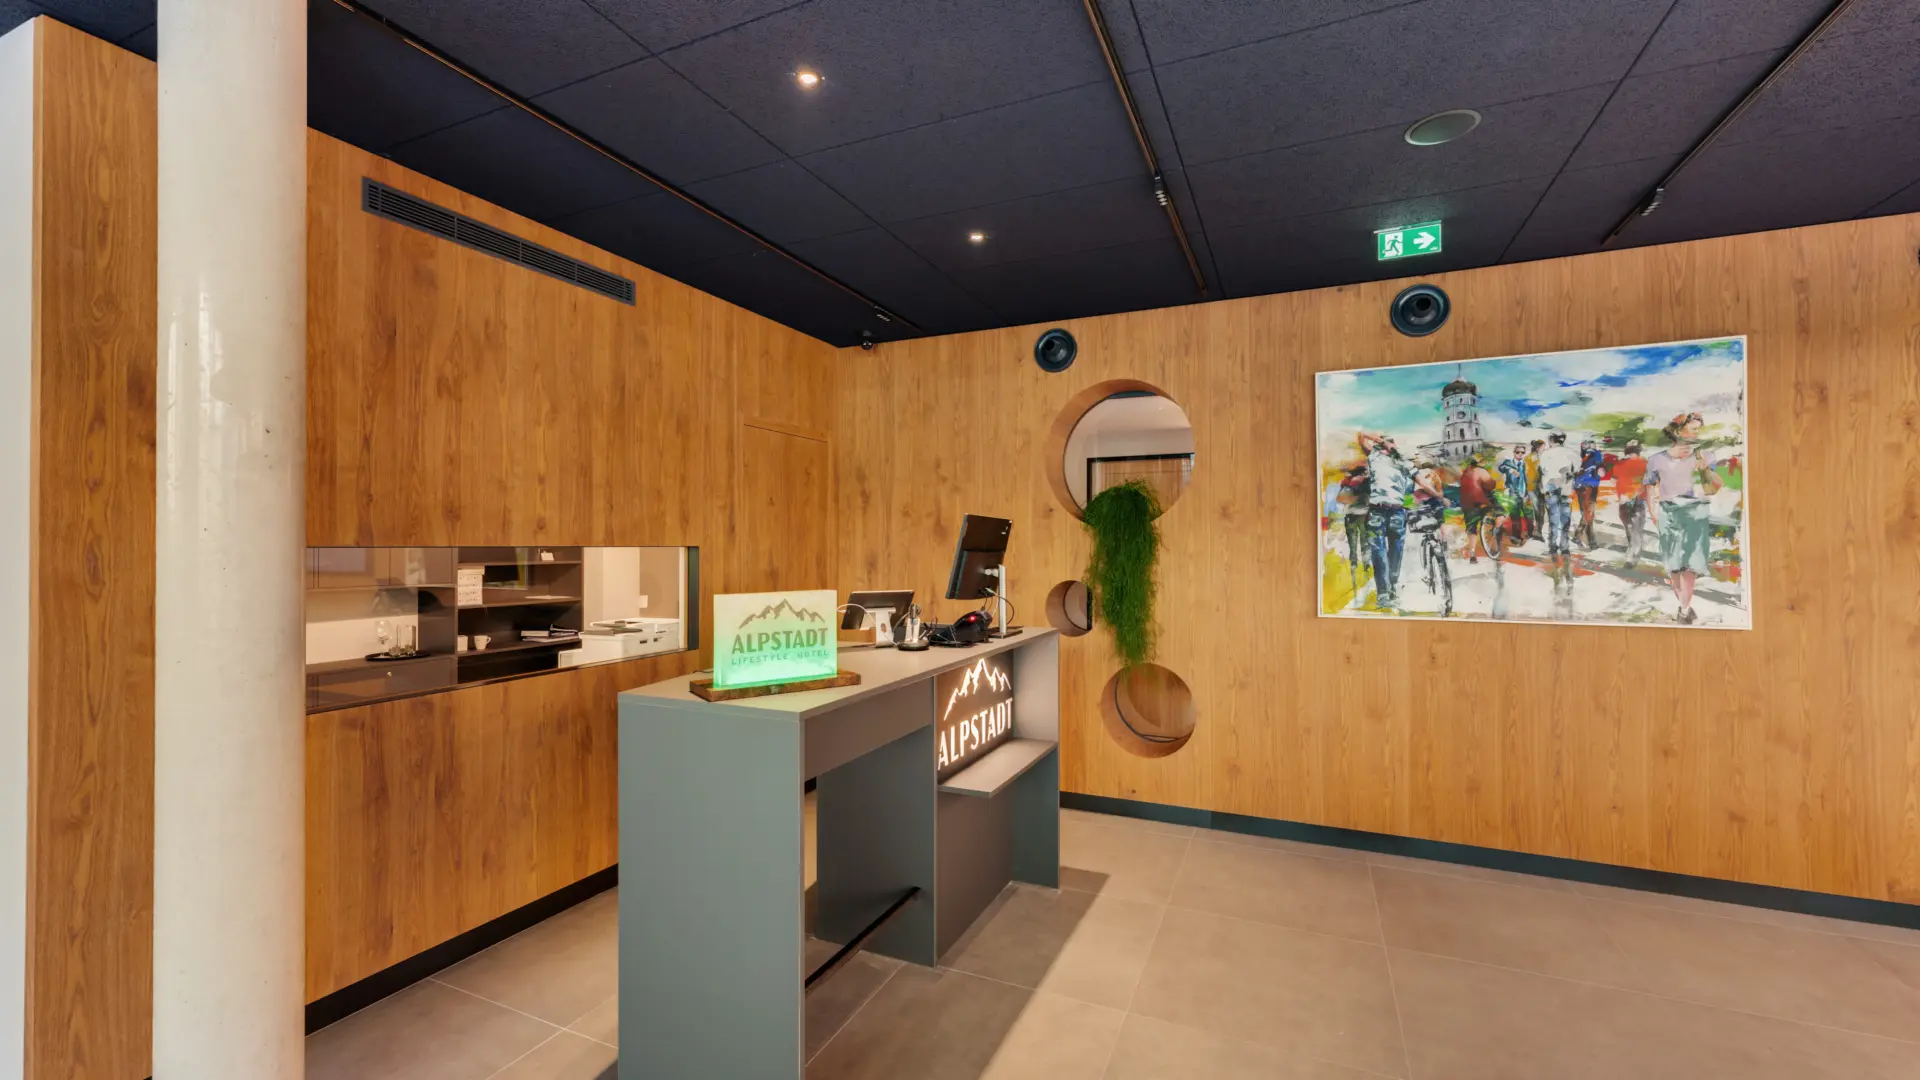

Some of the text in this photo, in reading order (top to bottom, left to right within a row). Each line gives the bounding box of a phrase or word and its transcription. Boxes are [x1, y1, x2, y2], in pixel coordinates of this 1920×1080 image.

[731, 628, 828, 655] ALPSTADT
[731, 650, 829, 665] LIFESTYLE HOTEL
[937, 697, 1013, 771] ALPSTADT
